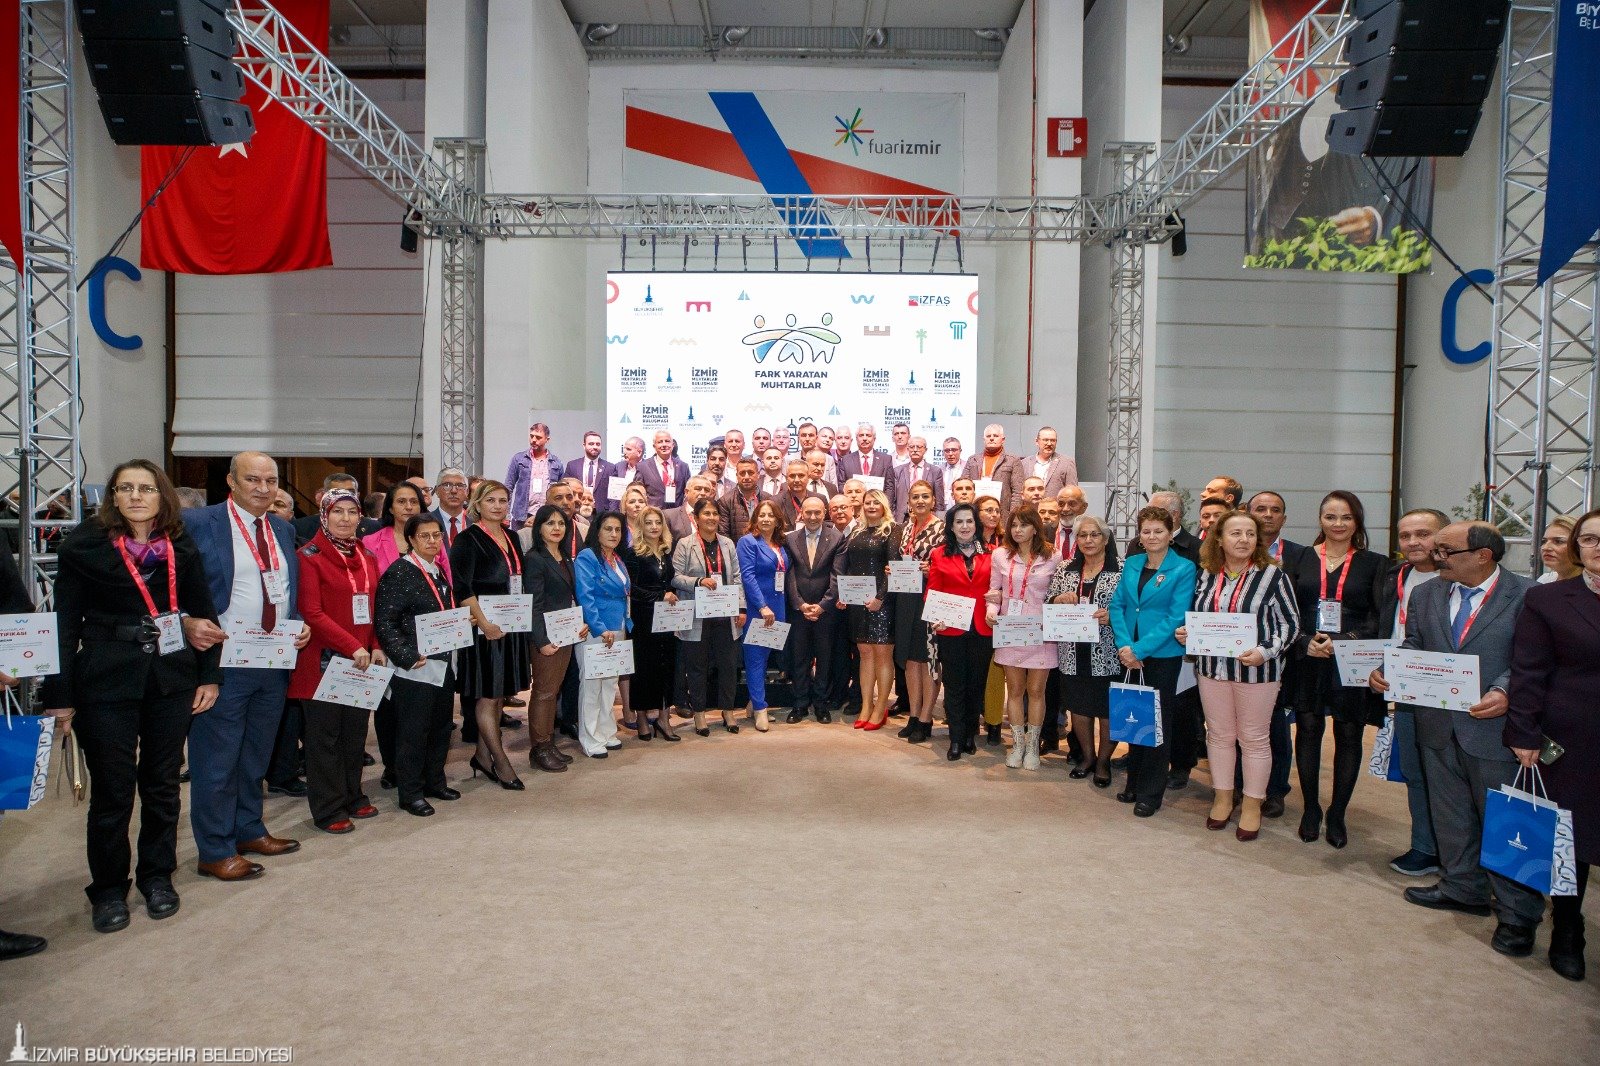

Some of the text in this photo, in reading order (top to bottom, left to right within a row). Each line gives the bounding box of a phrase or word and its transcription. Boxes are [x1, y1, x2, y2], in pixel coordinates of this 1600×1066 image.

[869, 138, 942, 155] fuarizmir
[621, 366, 647, 377] İZMİR
[691, 366, 718, 377] İZMİR
[754, 370, 781, 378] FARK
[863, 368, 889, 378] İZMİR
[934, 369, 960, 379] İZMİR
[760, 381, 822, 389] MUHTARLAR
[642, 404, 669, 414] İZMİR
[884, 406, 911, 416] İZMİR
